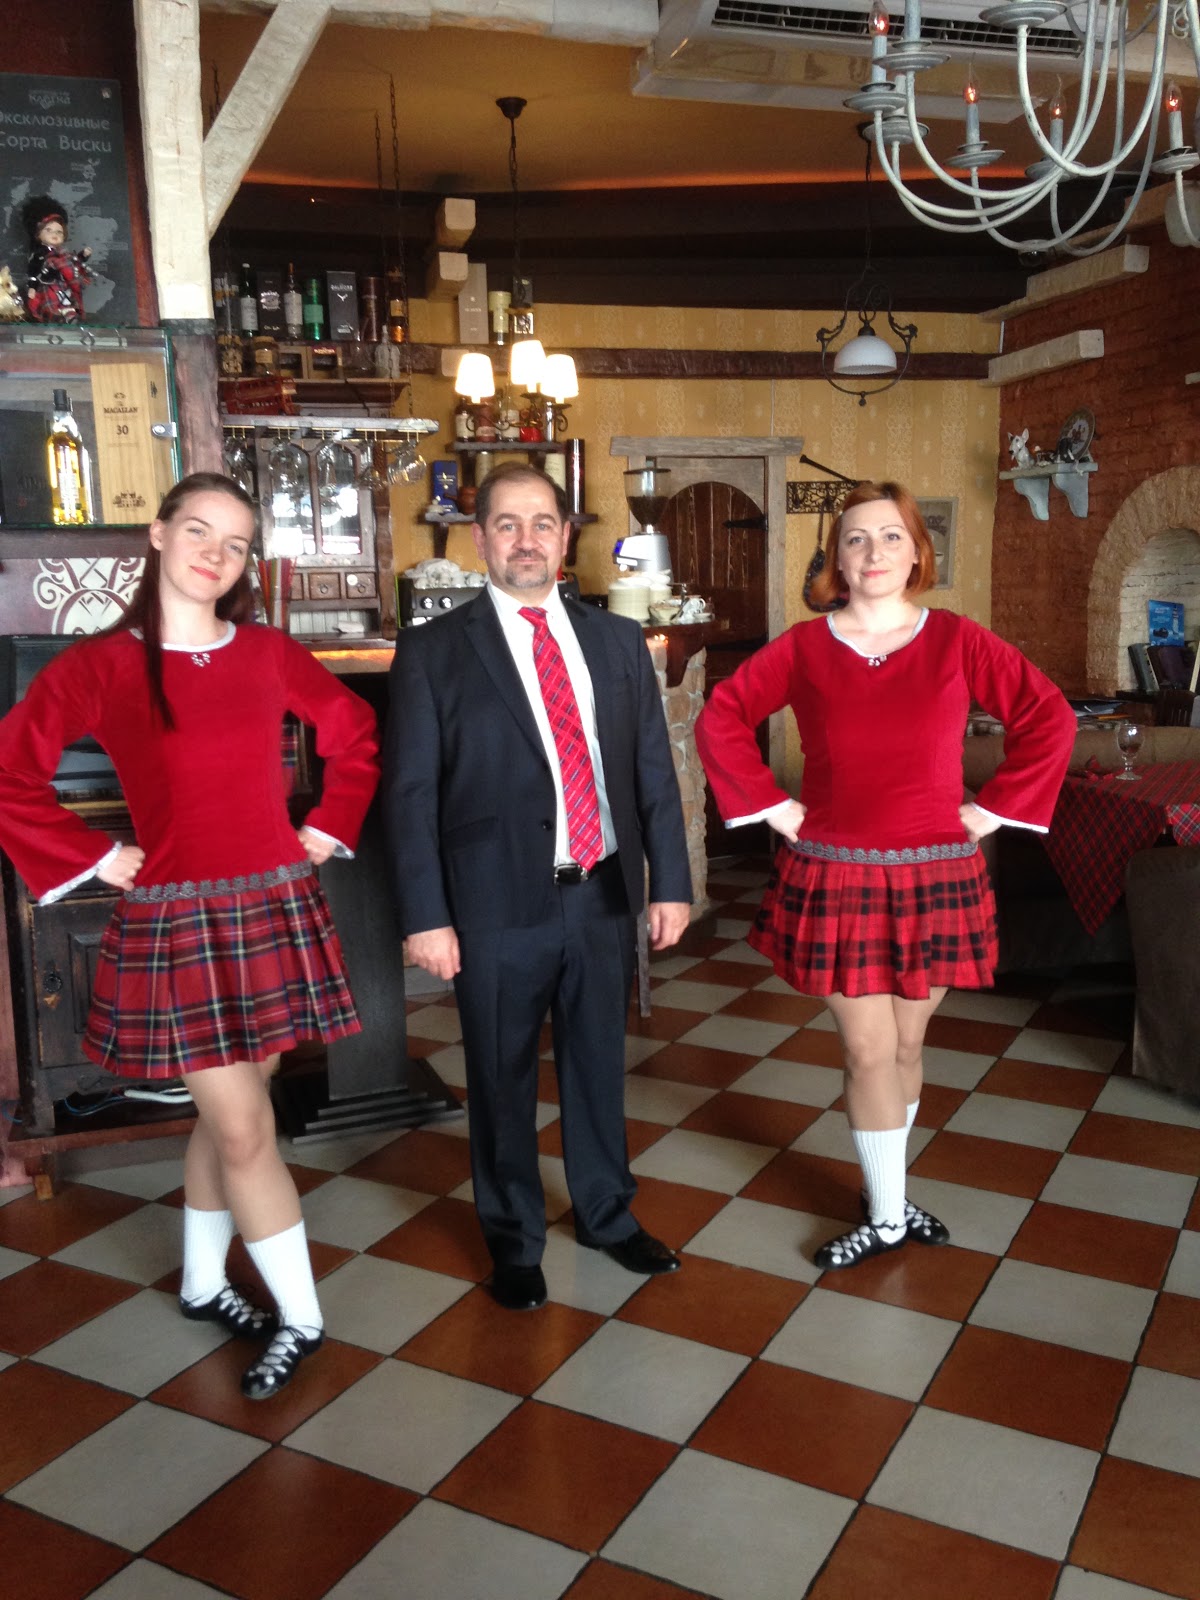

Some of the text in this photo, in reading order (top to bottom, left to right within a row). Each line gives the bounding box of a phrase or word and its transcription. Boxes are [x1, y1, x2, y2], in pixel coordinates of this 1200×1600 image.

[59, 134, 112, 152] Виски
[103, 406, 138, 414] MACALLAN
[116, 424, 129, 436] 30
